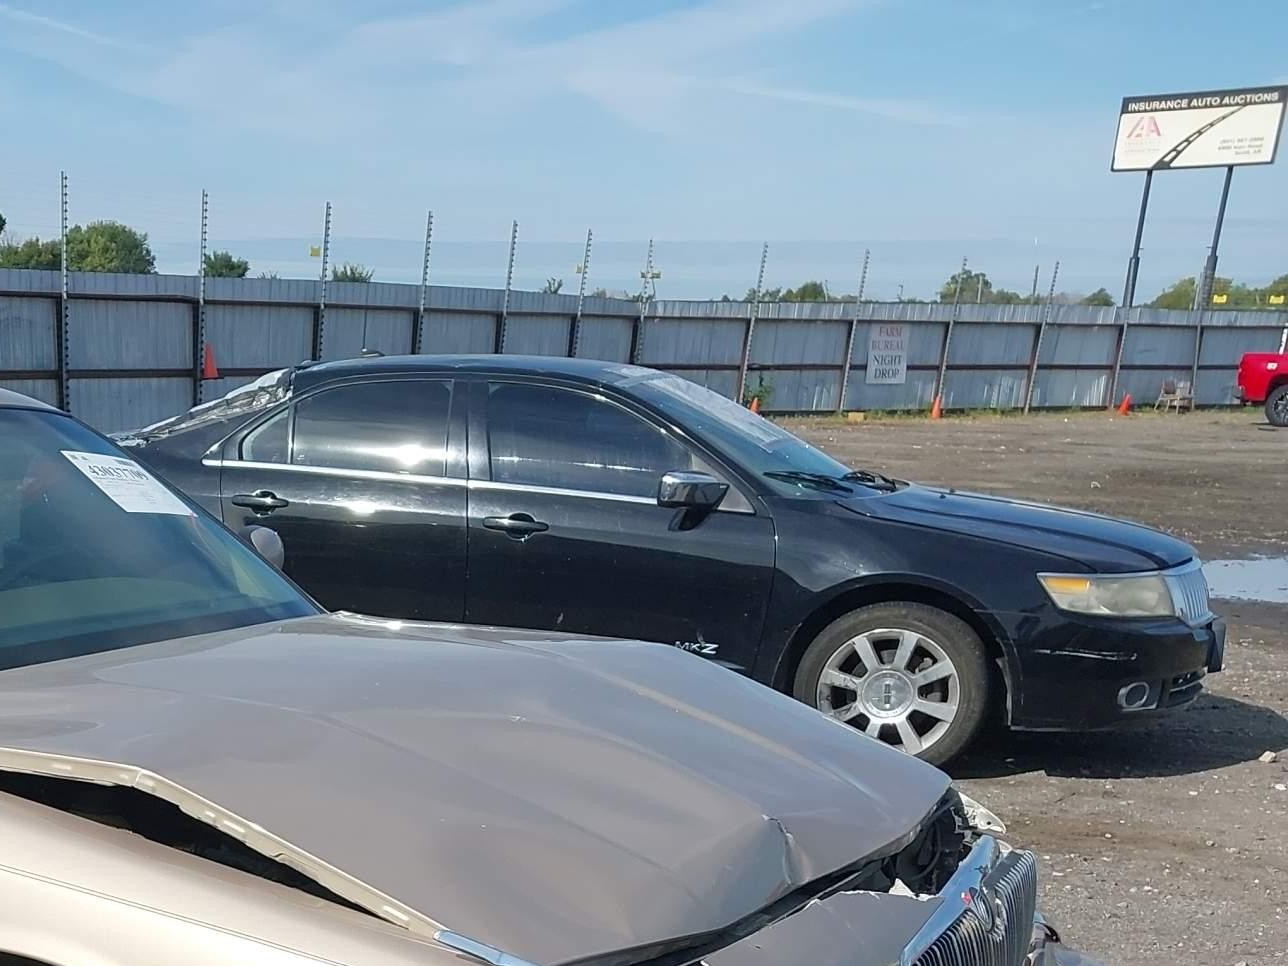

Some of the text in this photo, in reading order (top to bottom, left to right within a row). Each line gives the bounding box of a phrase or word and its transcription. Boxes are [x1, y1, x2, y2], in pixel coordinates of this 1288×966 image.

[1128, 91, 1279, 112] INSURANCE AUTO AUCTIONS
[879, 326, 903, 337] FARM
[873, 354, 902, 366] NIGHT
[874, 367, 900, 379] DROP
[675, 641, 720, 655] MKZ
